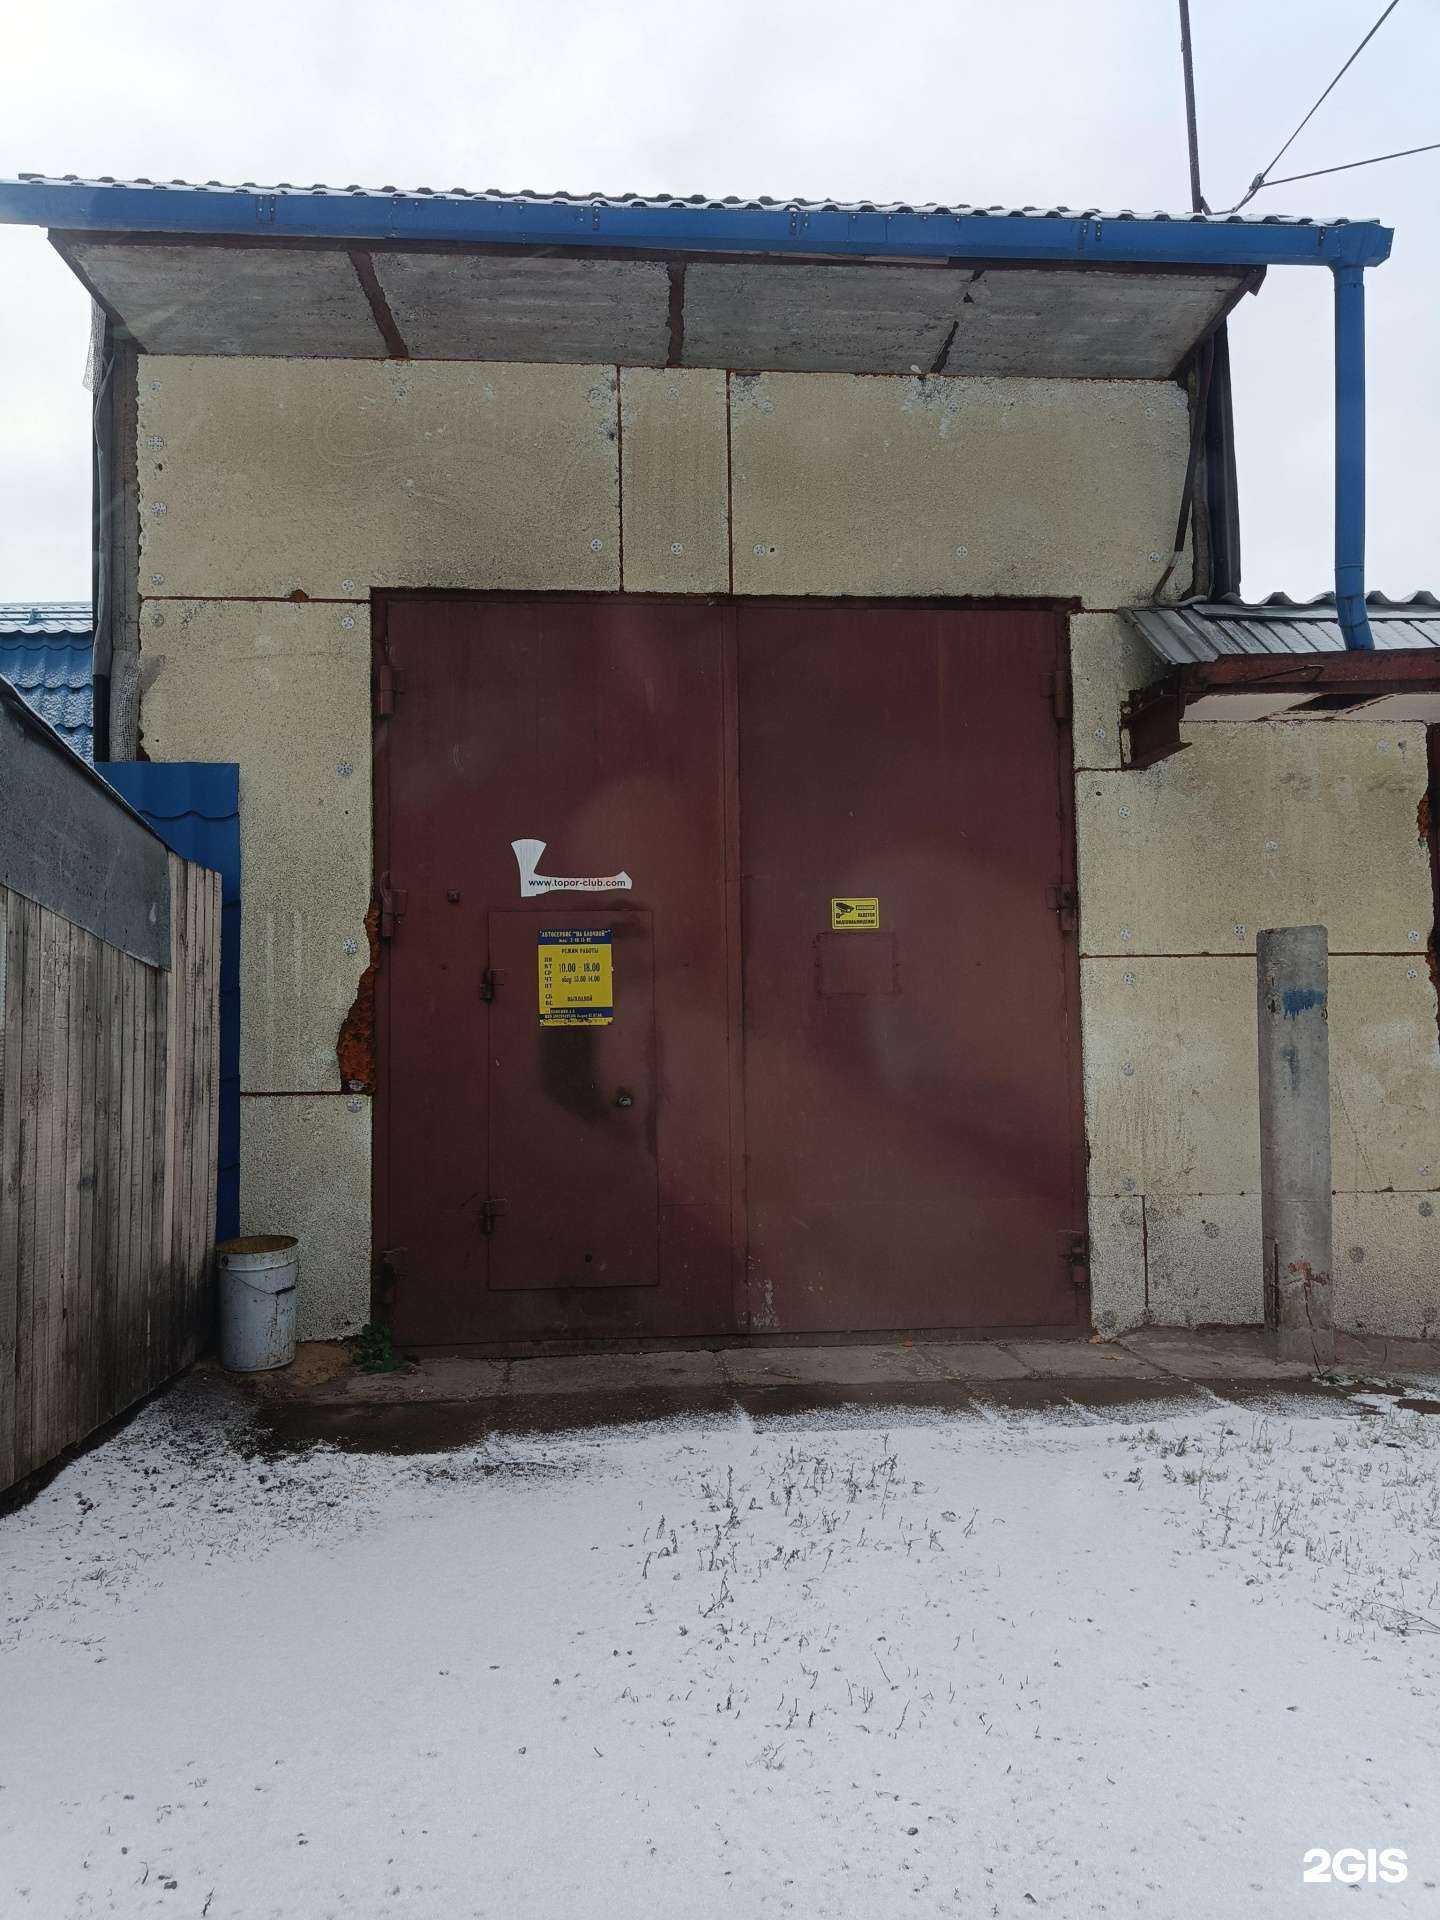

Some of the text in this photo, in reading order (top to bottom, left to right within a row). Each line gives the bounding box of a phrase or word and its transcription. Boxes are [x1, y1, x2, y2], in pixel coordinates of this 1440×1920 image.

[528, 878, 626, 888] www.topor-club.com
[559, 963, 576, 973] 10.00
[583, 962, 600, 972] 18.00
